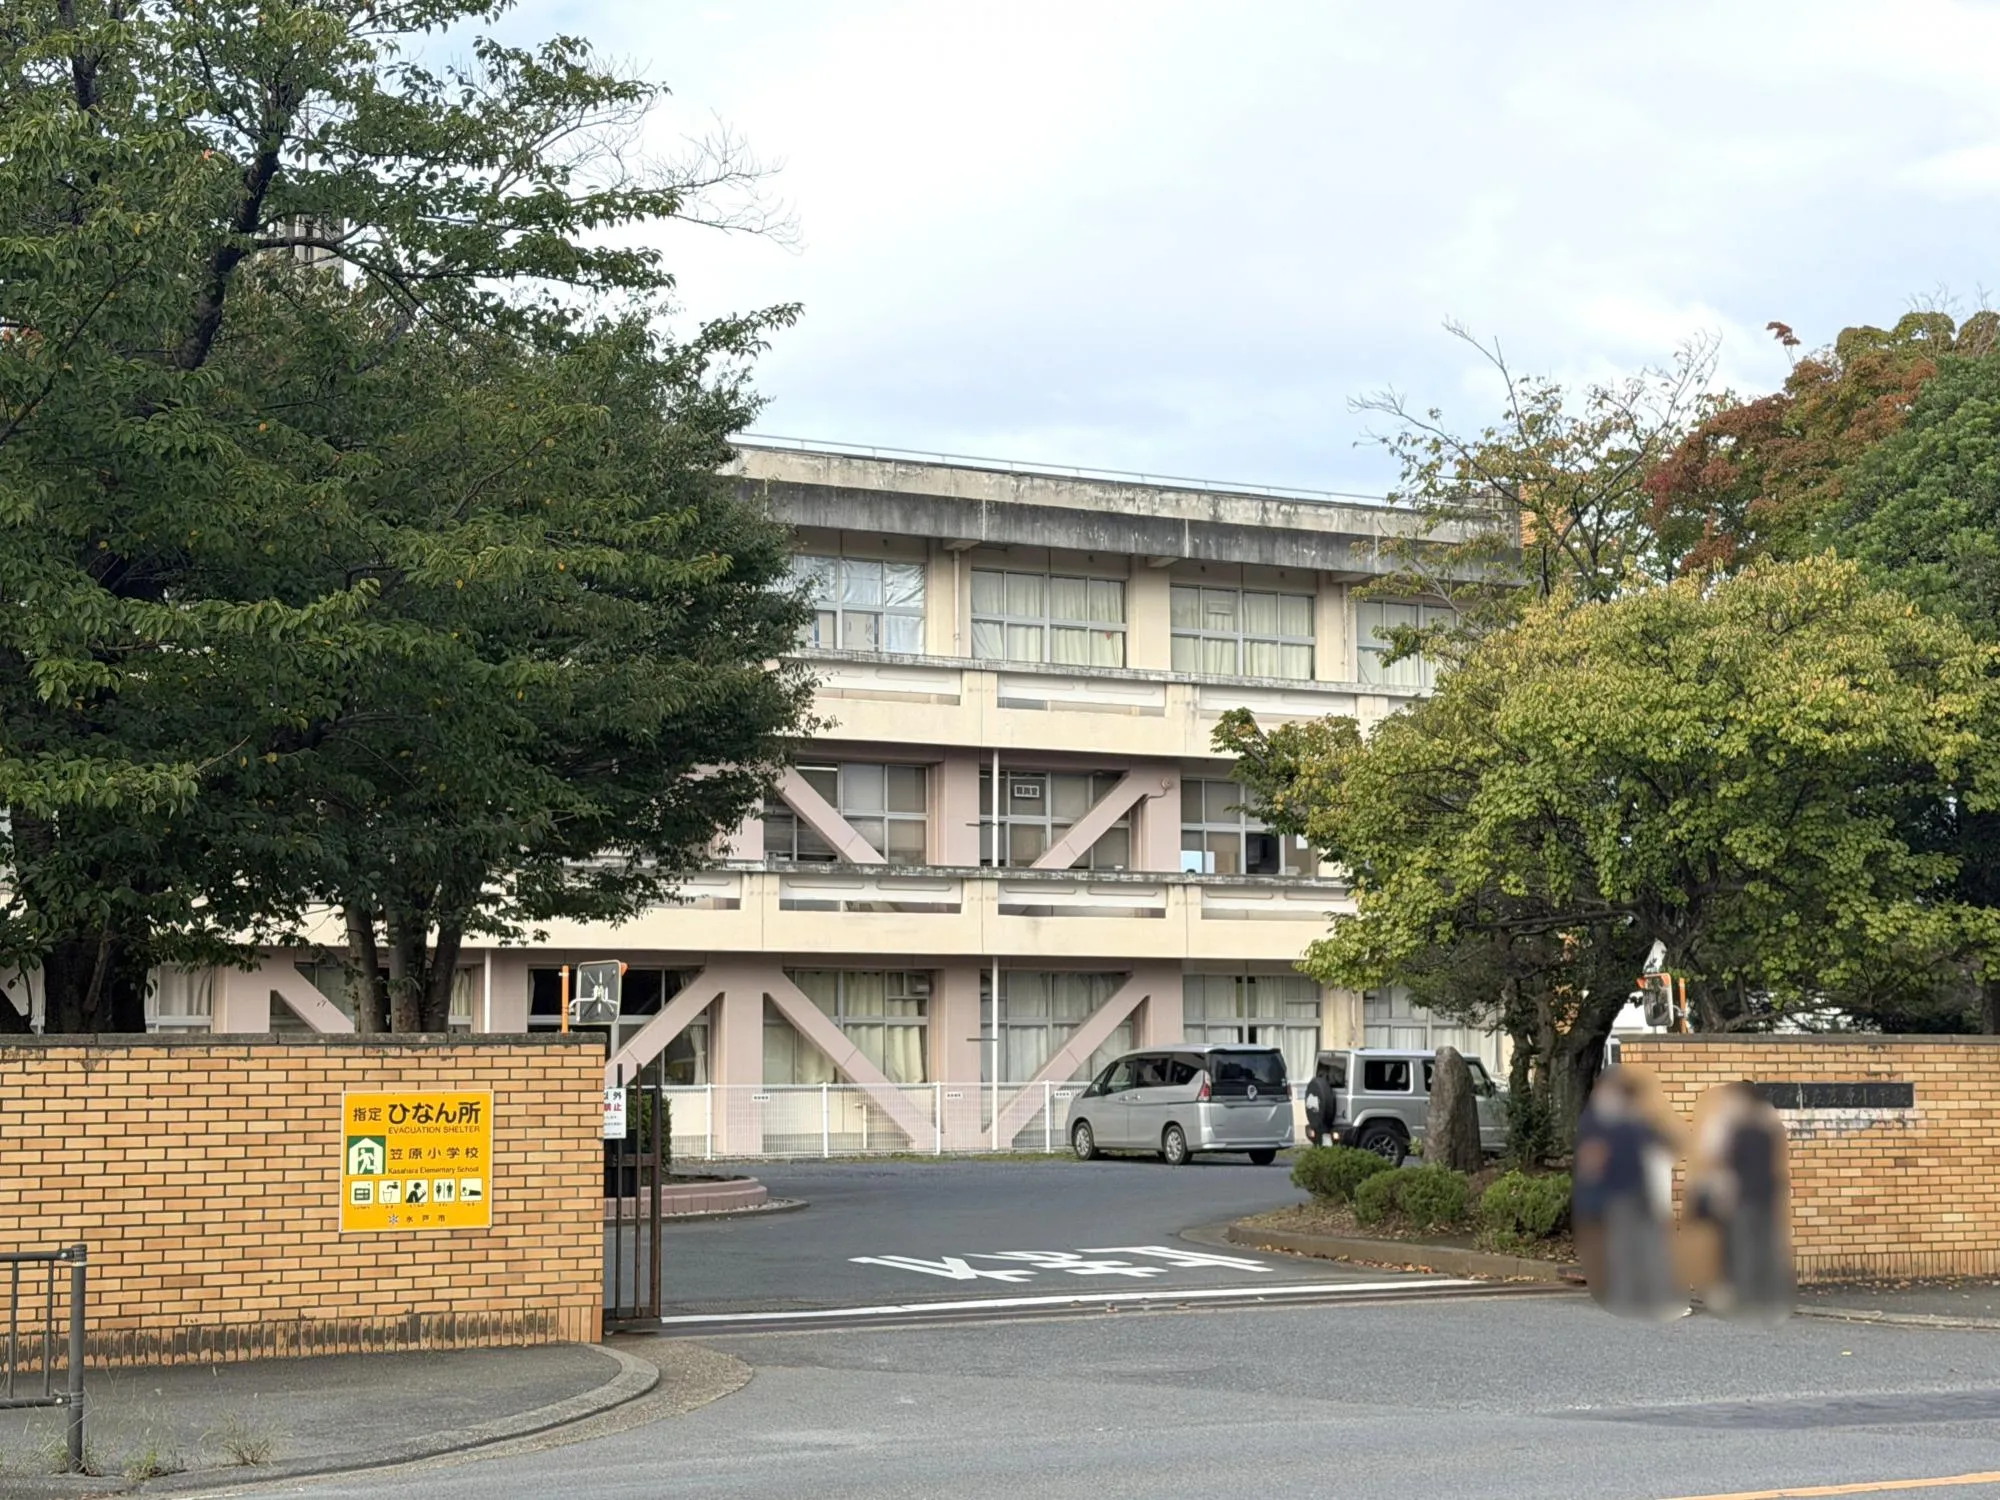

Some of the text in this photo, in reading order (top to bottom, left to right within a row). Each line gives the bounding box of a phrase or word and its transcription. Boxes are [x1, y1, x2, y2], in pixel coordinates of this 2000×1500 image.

[353, 1101, 481, 1124] 指定 ひなん所
[388, 1125, 480, 1135] EVACUATION SHELTER
[389, 1147, 479, 1161] 笠原小学校
[388, 1167, 419, 1175] Kasahara
[419, 1166, 455, 1175] Elementary
[406, 1214, 446, 1223] 水戸市
[848, 1245, 1274, 1283] 止まれ
